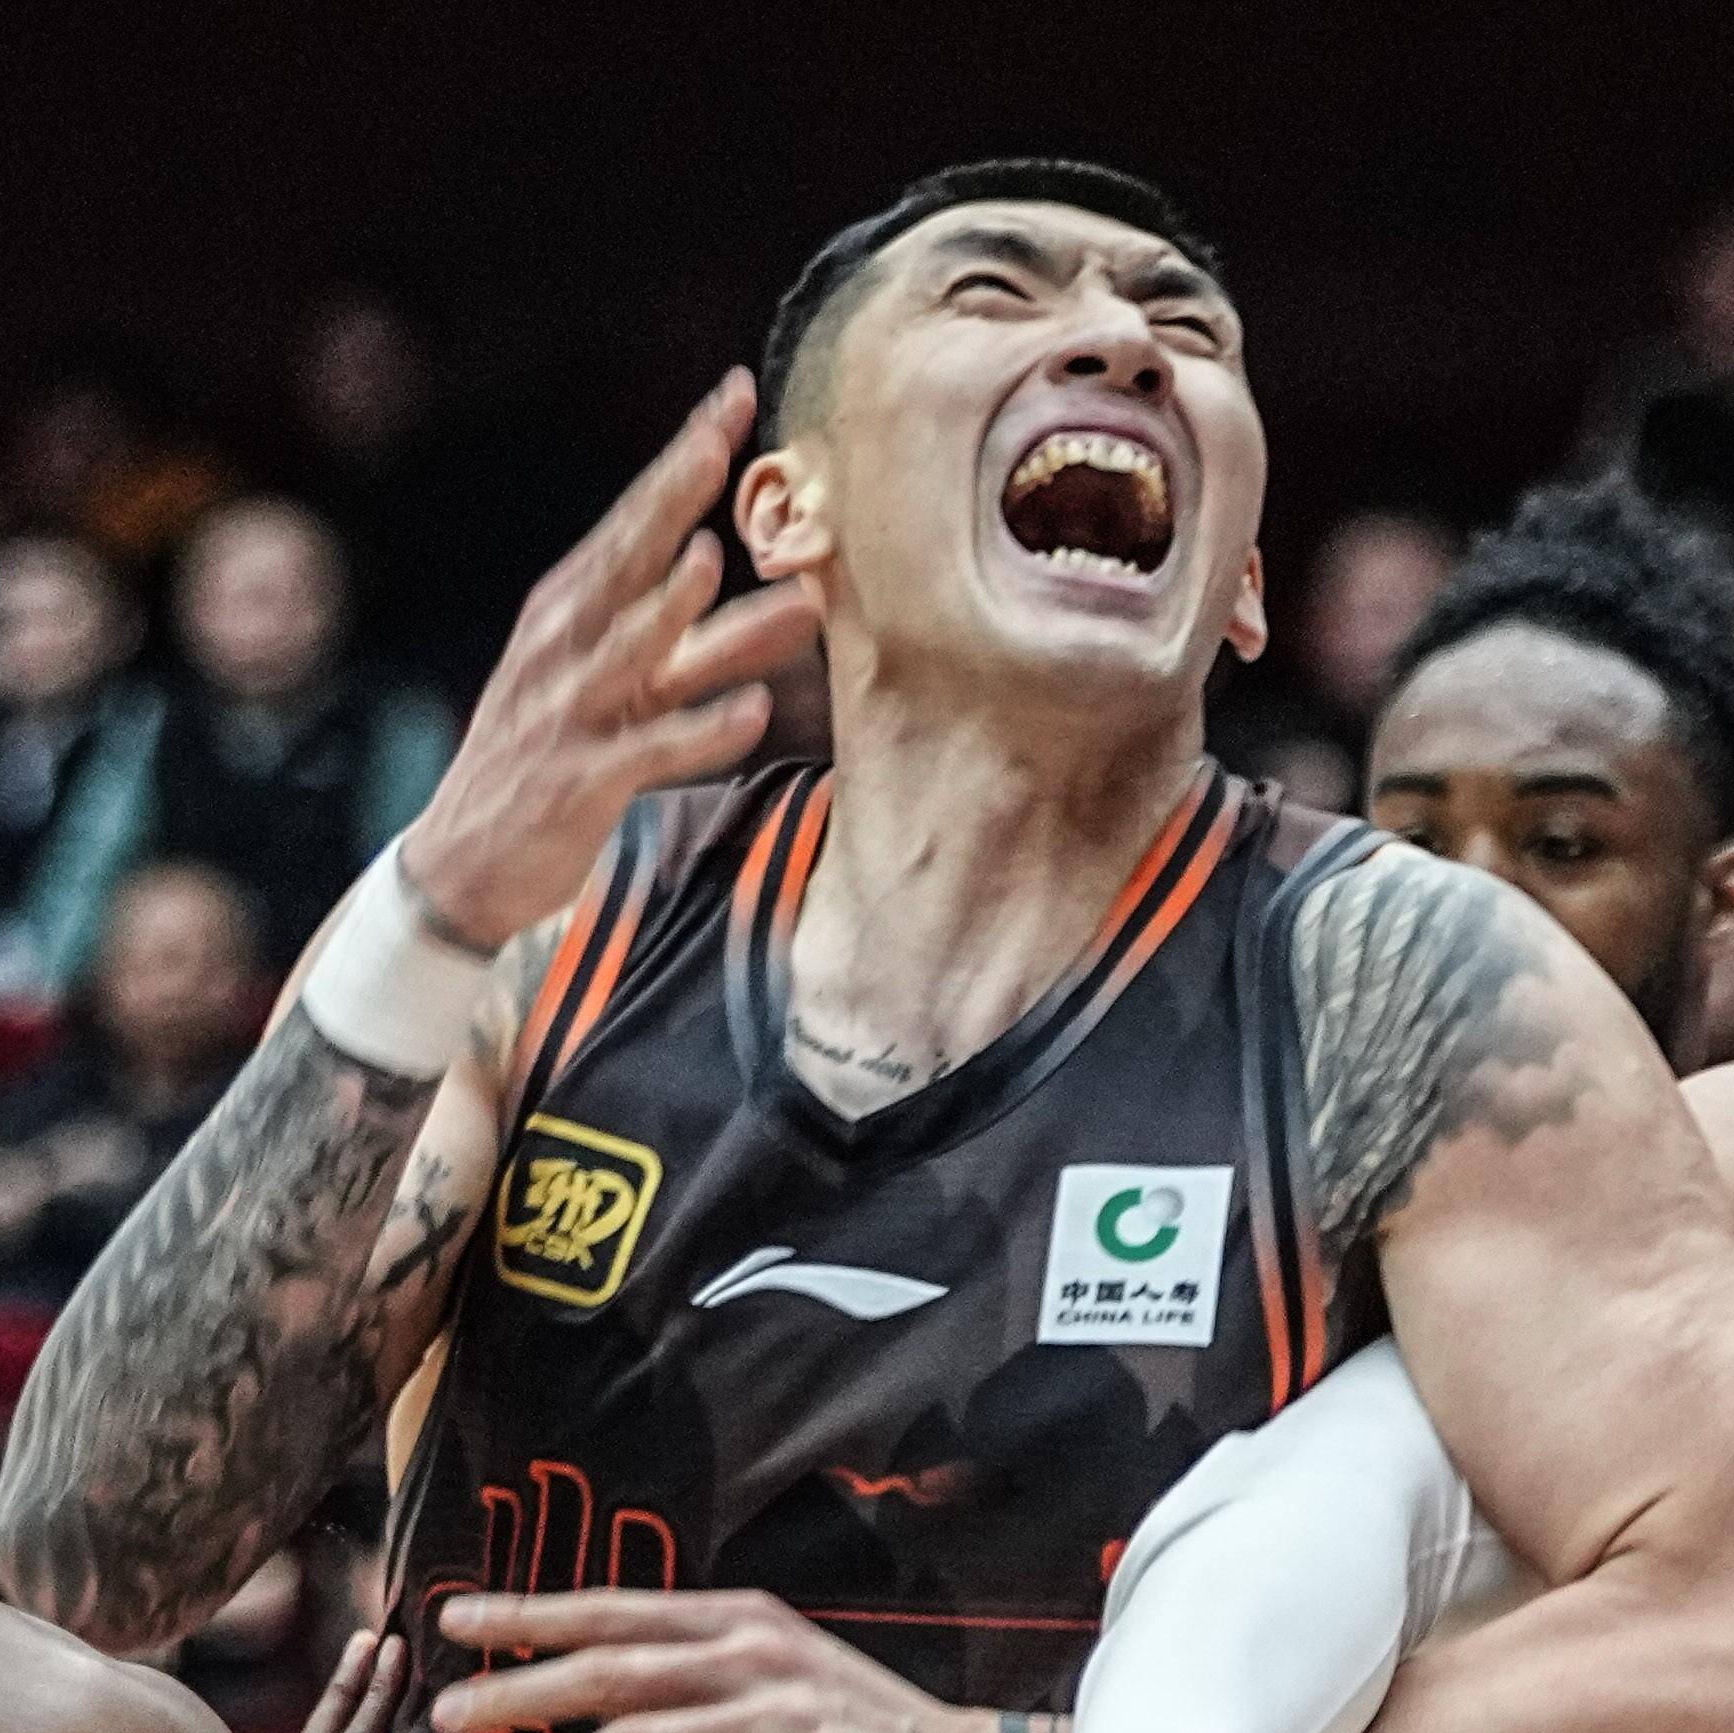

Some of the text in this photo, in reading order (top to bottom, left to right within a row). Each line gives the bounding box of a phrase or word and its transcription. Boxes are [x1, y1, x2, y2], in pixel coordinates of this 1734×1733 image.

[1060, 1278, 1201, 1307] 中国人寿
[1056, 1308, 1196, 1325] CHINA LIFE
